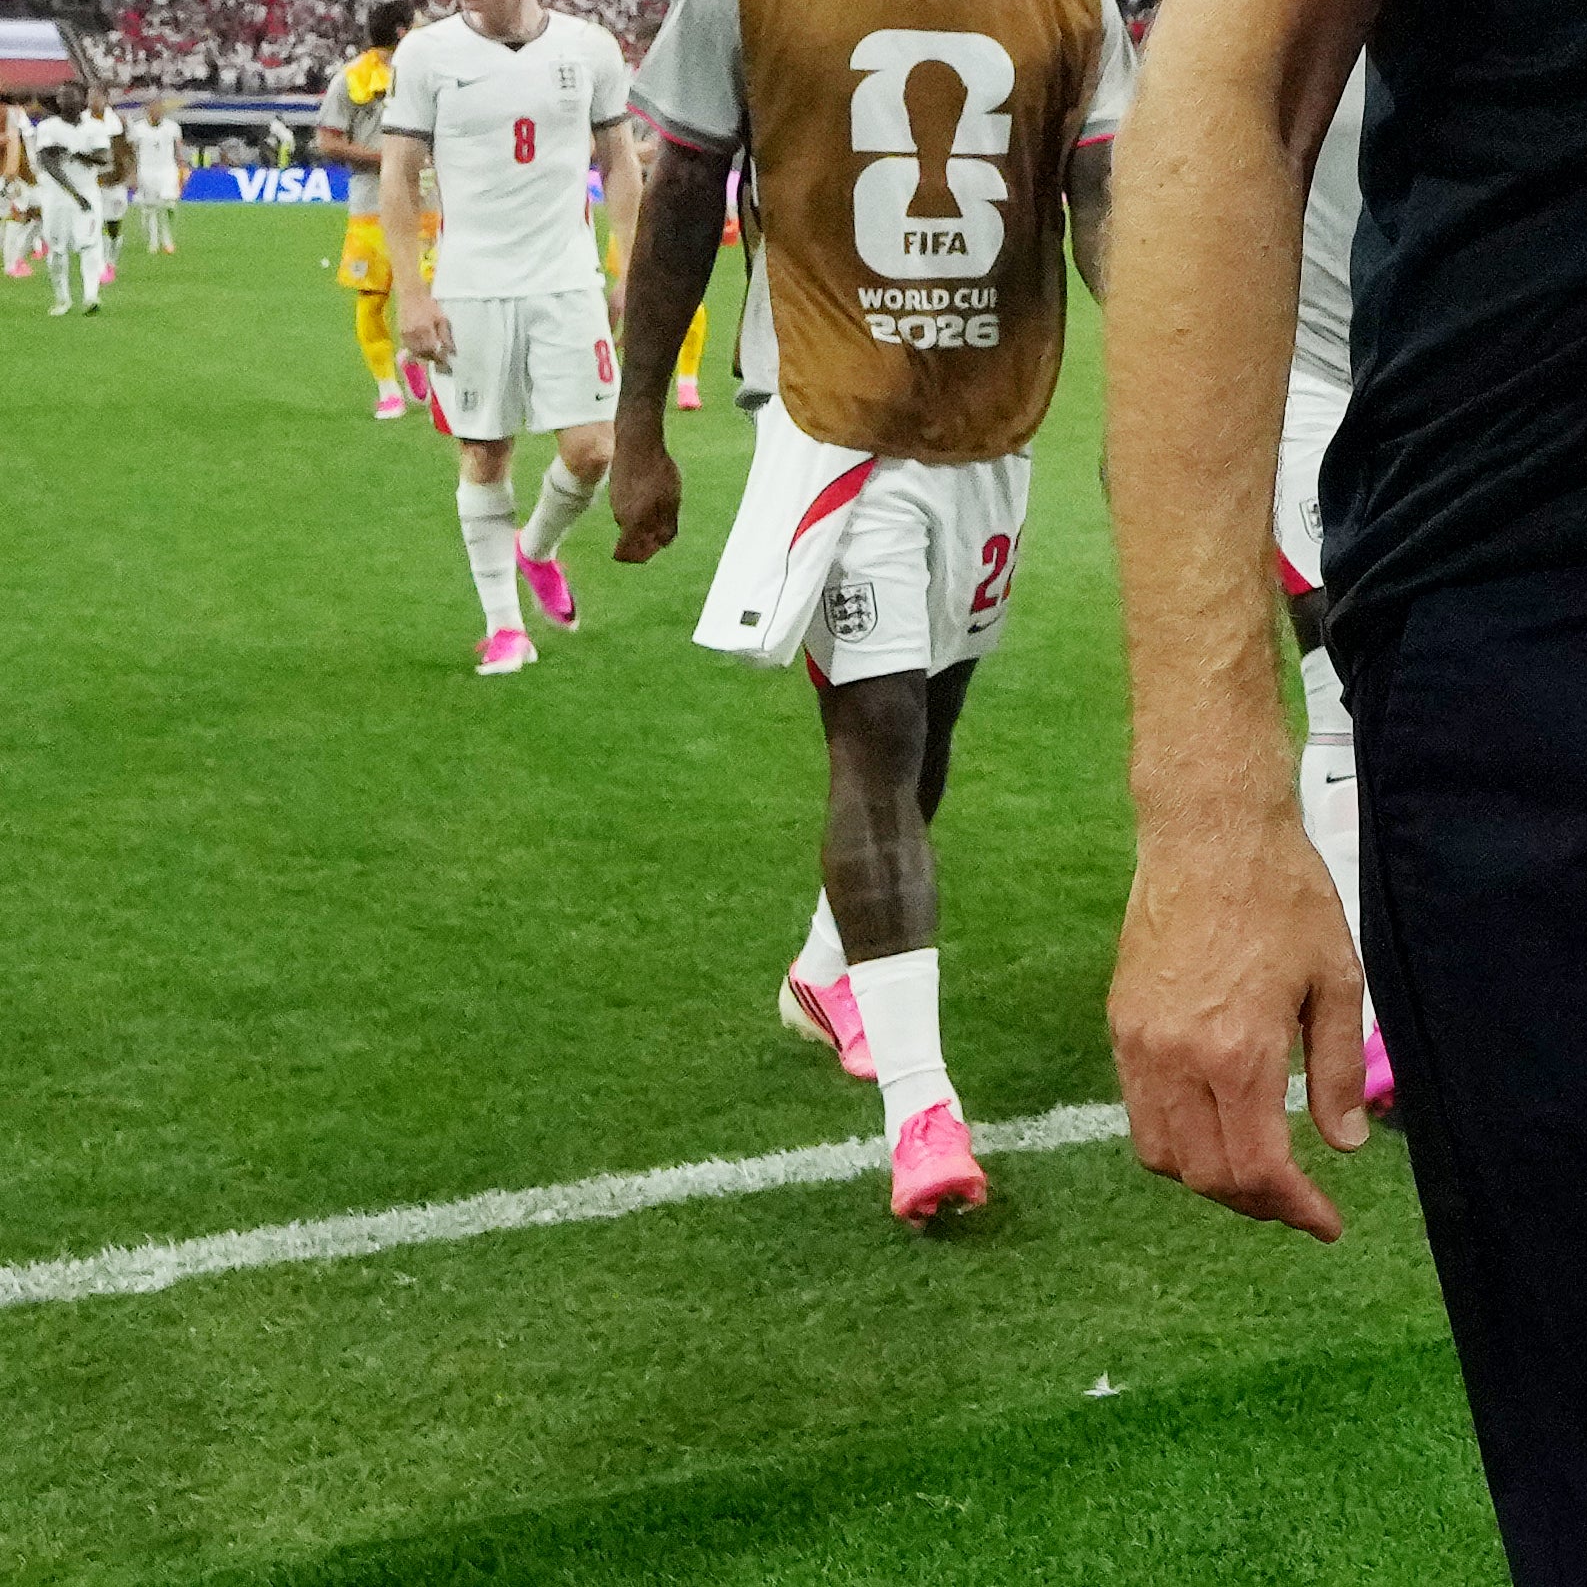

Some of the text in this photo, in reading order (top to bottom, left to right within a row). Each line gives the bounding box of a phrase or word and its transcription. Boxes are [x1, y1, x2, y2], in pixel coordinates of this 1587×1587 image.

[513, 116, 536, 165] 8
[227, 166, 333, 203] VISA
[904, 231, 968, 256] FIFA
[857, 287, 950, 311] WORLD
[865, 313, 1001, 350] 2026
[594, 339, 614, 384] 8
[970, 534, 1019, 615] 2
